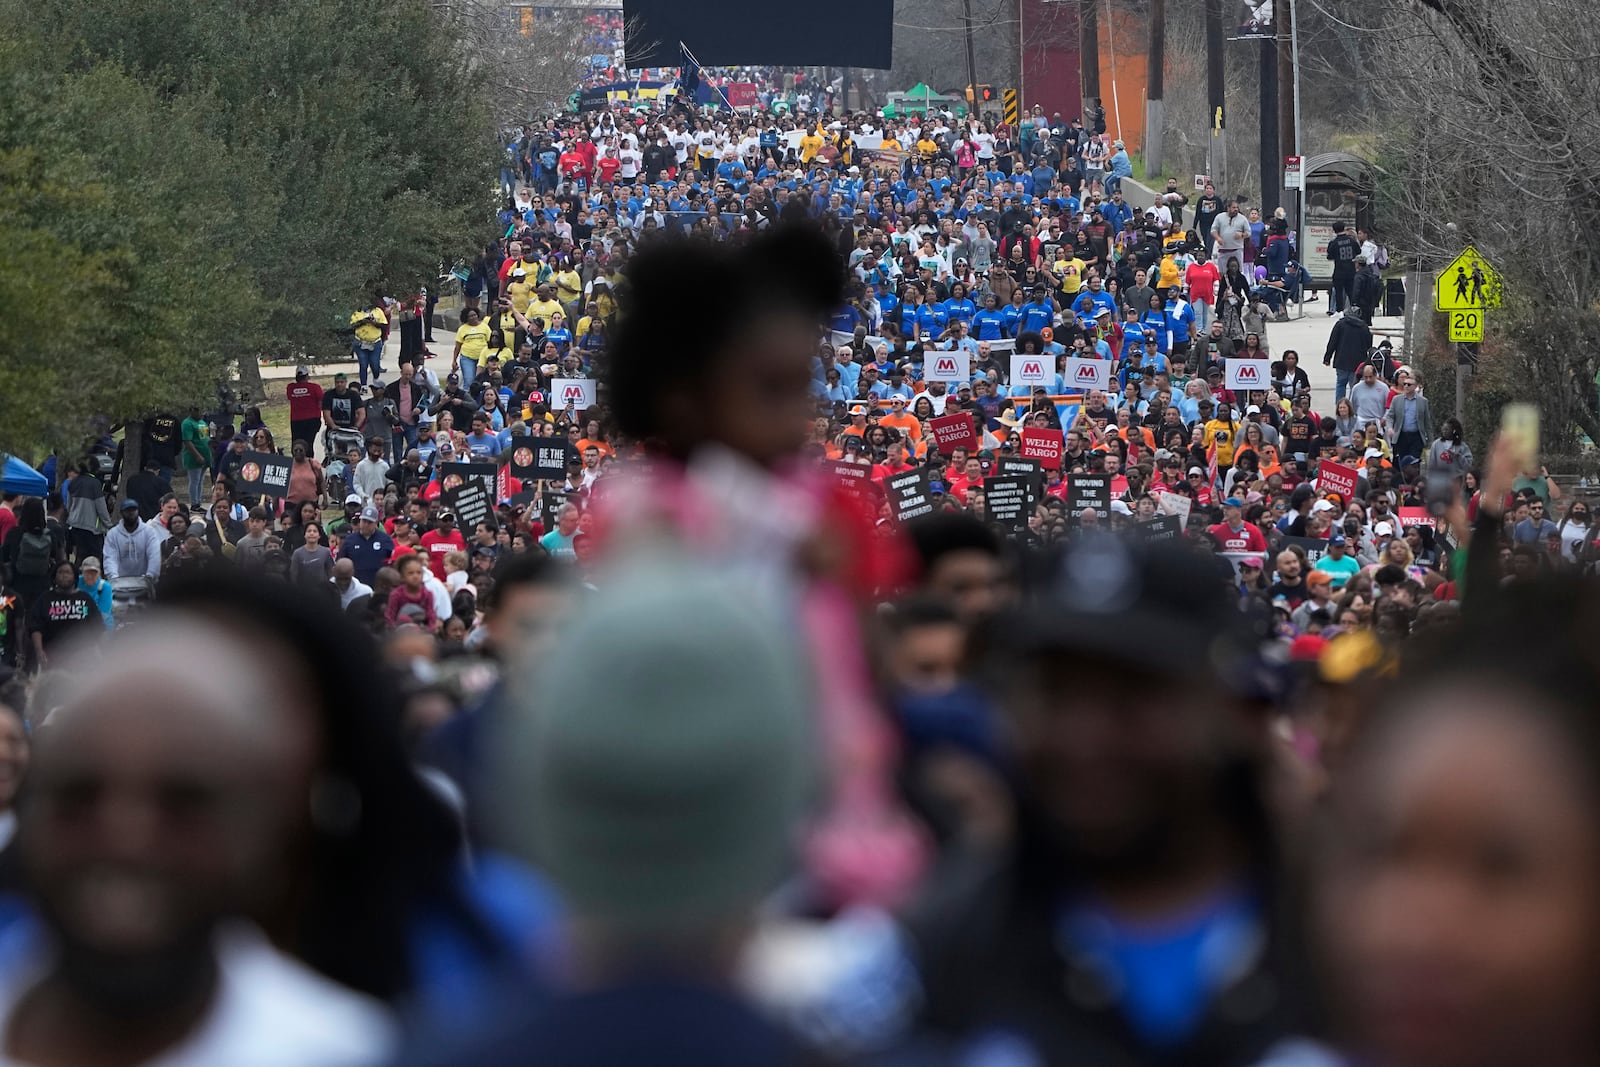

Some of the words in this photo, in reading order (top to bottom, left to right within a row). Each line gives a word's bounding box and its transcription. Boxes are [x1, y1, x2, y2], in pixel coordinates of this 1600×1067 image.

[1454, 313, 1477, 329] 20
[936, 423, 967, 435] WELLS
[940, 431, 970, 443] FARGO
[1025, 438, 1058, 449] WELLS
[539, 448, 549, 459] BE
[551, 449, 564, 459] THE
[1024, 447, 1058, 458] FARGO
[539, 460, 564, 469] CHANGE
[1004, 462, 1033, 471] MOVING
[265, 465, 274, 475] BE
[275, 466, 288, 477] THE
[835, 466, 865, 478] MOVING
[263, 475, 286, 486] CHANGE
[891, 474, 920, 490] MOVING
[1074, 479, 1104, 487] MOVING
[1322, 469, 1353, 488] WELLS
[901, 486, 917, 497] THE
[1320, 479, 1351, 496] FARGO
[1082, 489, 1096, 498] THE
[899, 495, 926, 510] DREAM
[897, 504, 933, 521] FORWARD
[1401, 517, 1435, 525] WELLS
[49, 606, 88, 615] ADVICE
